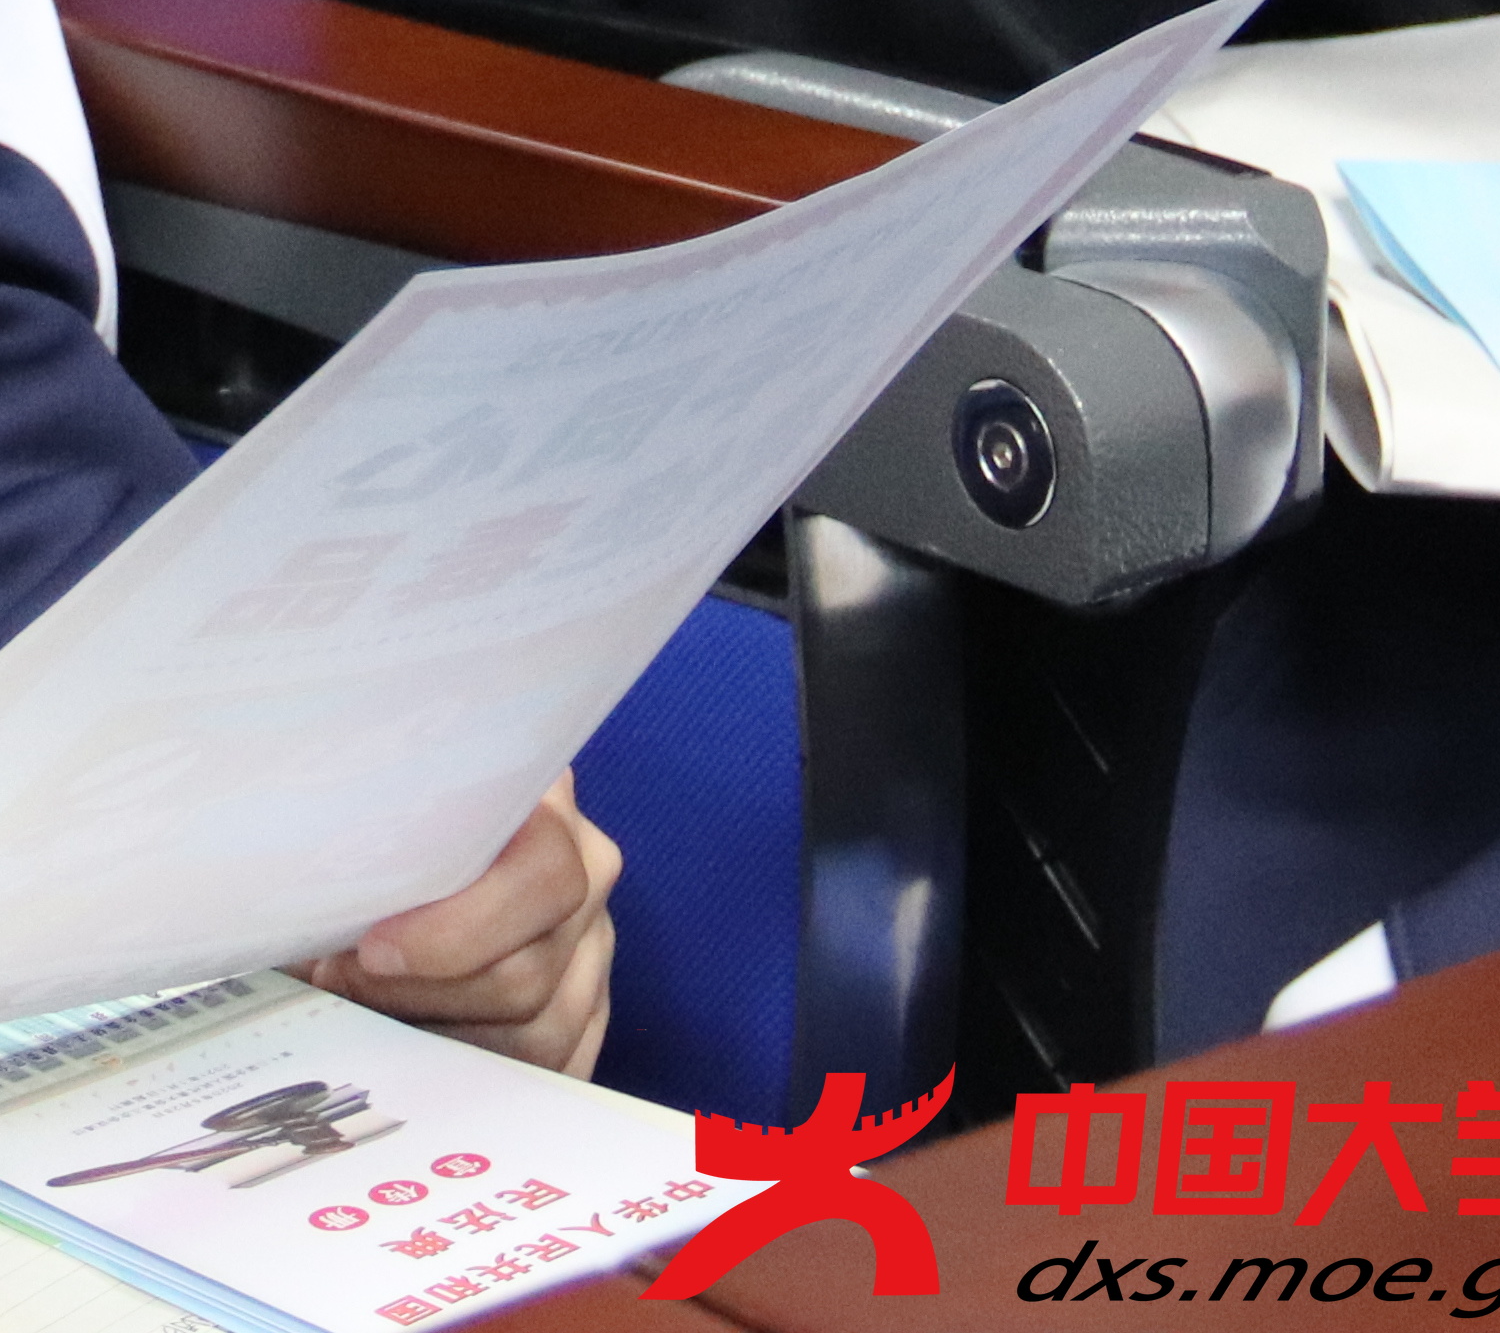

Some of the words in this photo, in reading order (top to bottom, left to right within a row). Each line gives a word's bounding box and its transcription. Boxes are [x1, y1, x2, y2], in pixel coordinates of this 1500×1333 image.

[312, 1154, 488, 1231] 宣传册
[378, 1178, 571, 1260] 民法典
[374, 1178, 716, 1326] 中华人民共和国
